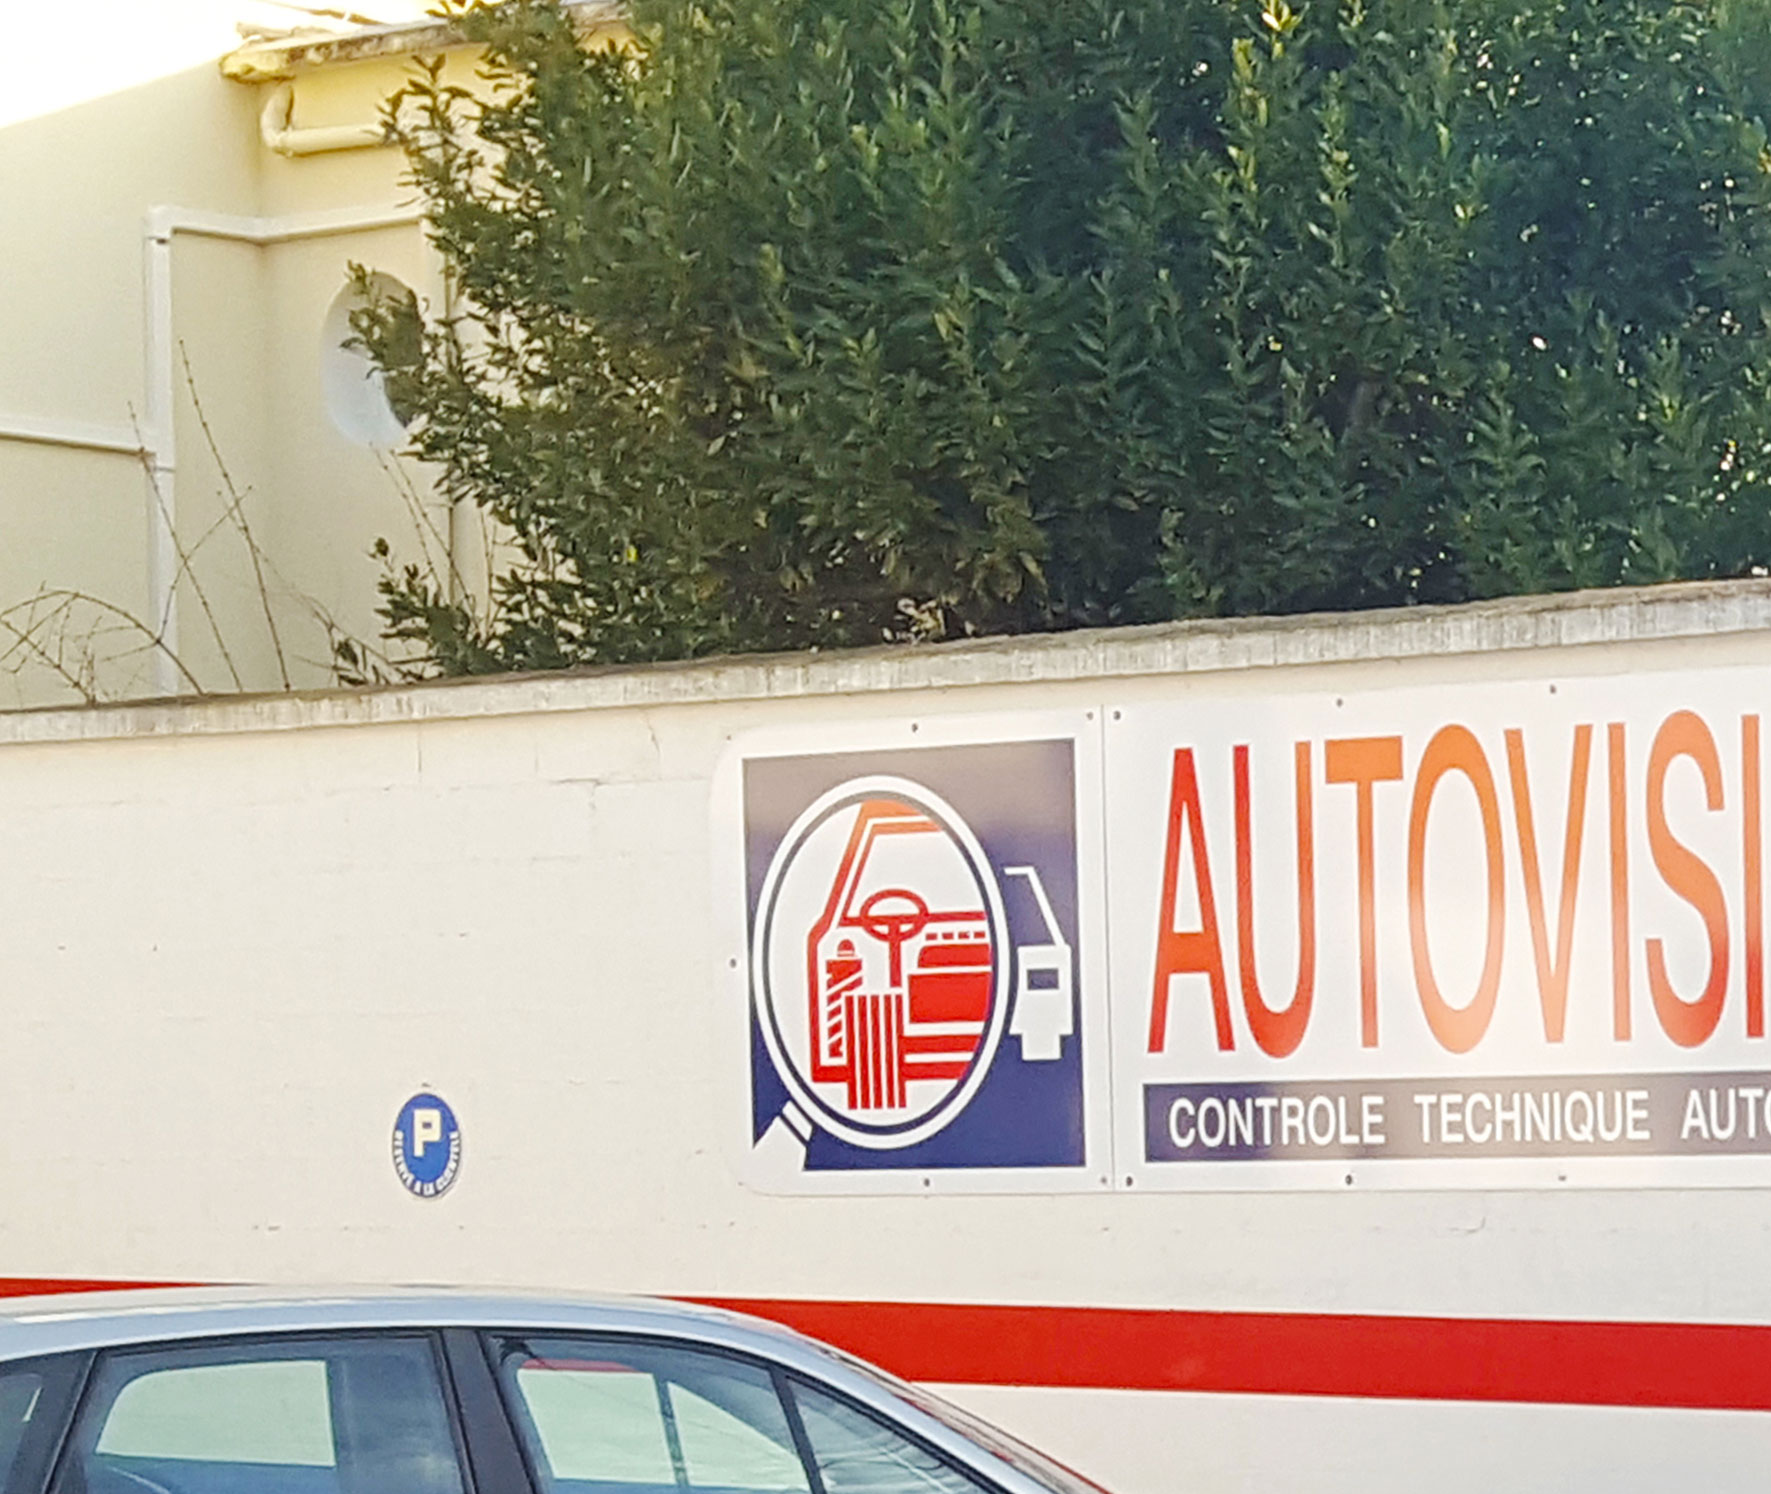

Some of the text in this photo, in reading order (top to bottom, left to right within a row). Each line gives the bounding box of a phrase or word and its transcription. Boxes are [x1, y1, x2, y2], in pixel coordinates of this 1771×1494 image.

[413, 1108, 441, 1157] P
[1168, 1096, 1386, 1148] CONTROLE
[1414, 1088, 1651, 1143] TECHNIQUE
